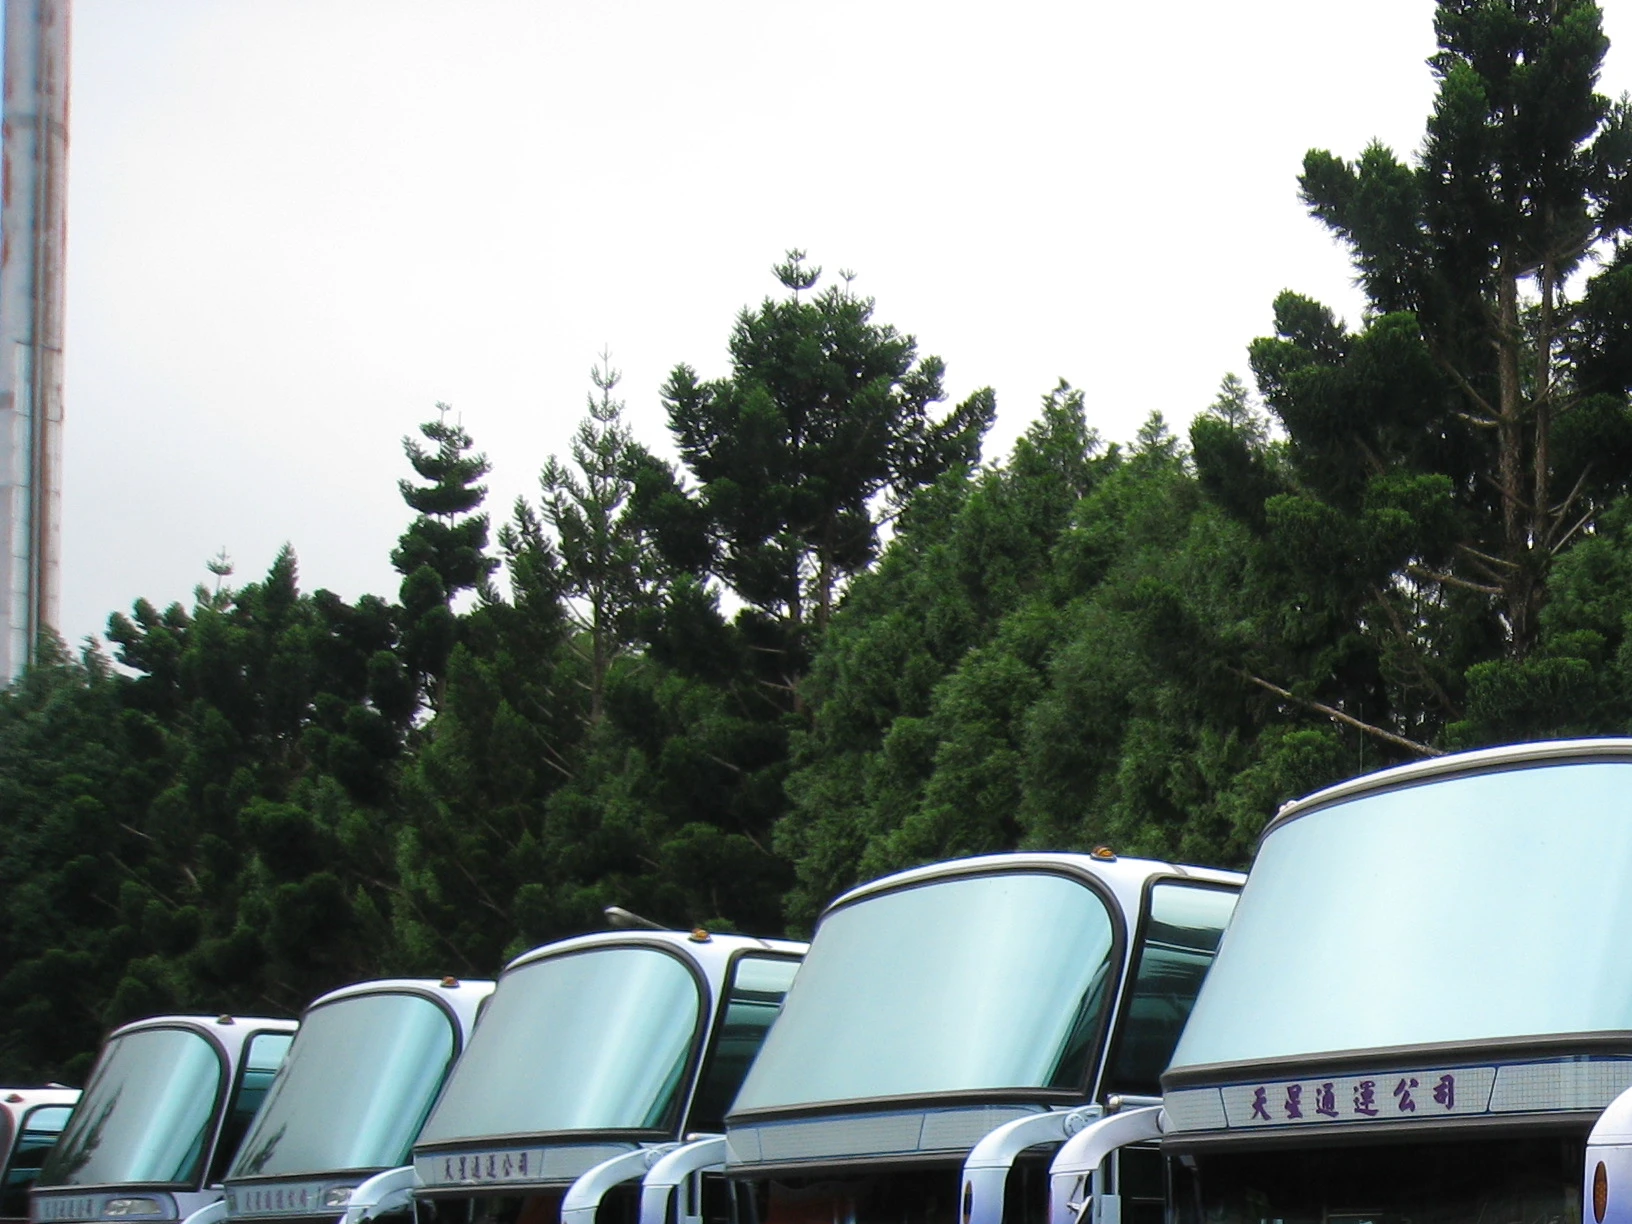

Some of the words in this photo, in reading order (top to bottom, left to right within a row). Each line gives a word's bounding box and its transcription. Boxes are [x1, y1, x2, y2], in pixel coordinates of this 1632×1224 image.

[1251, 1074, 1454, 1121] 天星通運公司
